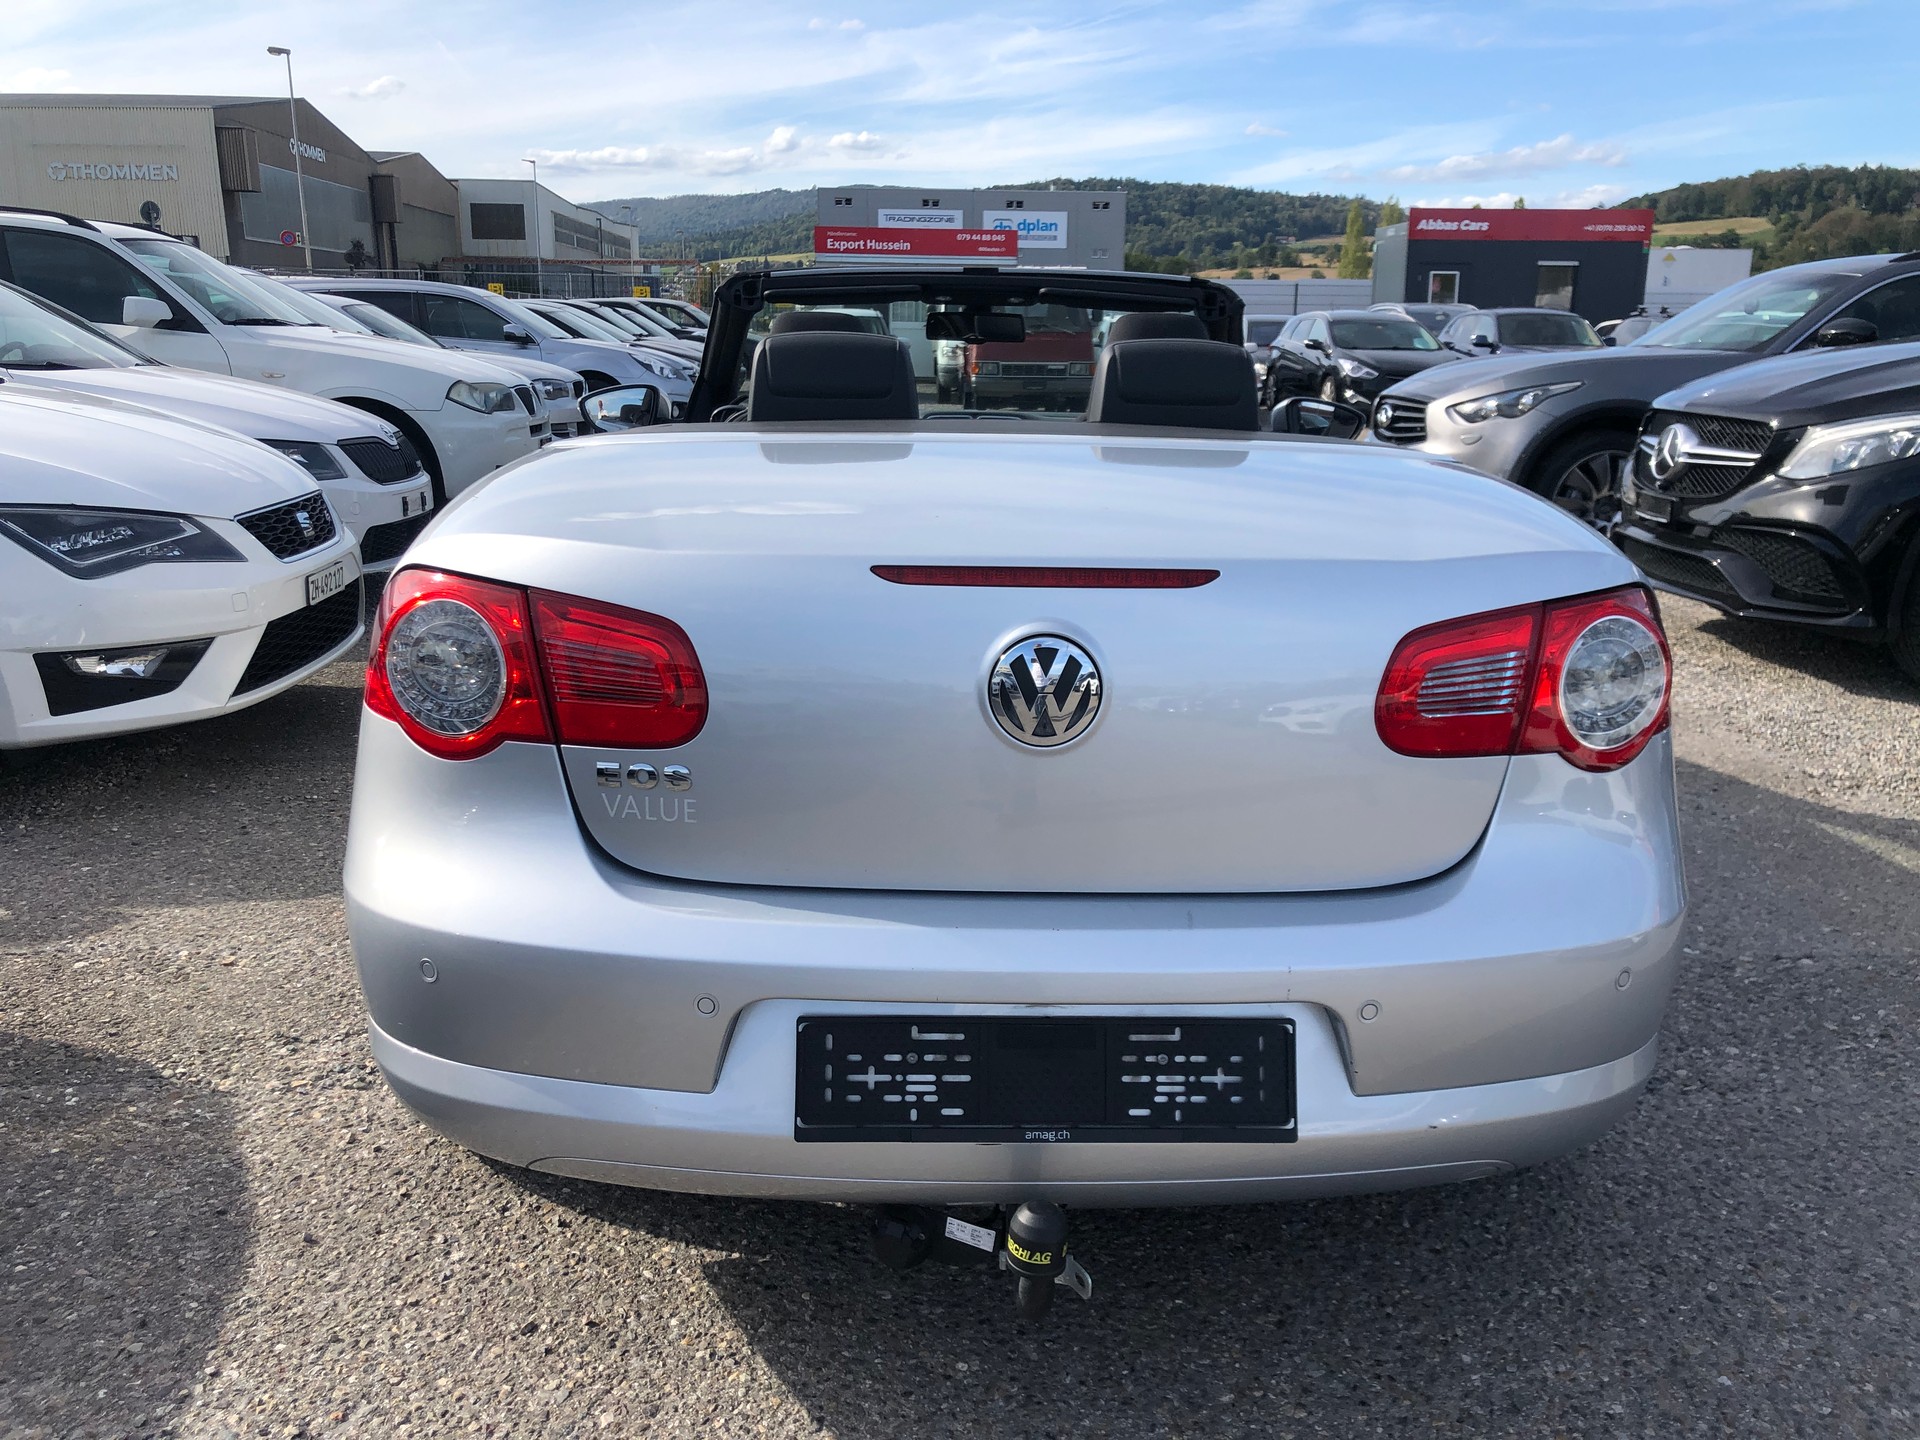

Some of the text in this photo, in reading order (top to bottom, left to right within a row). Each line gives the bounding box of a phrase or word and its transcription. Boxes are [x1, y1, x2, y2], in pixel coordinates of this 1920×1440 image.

[1017, 218, 1058, 234] dplan
[1416, 219, 1490, 231] Abbas Cars
[827, 238, 911, 251] Export Hussein
[596, 761, 693, 793] EOS
[601, 793, 697, 823] VALUE
[1025, 1130, 1070, 1141] amag.ch
[1031, 1252, 1052, 1262] AG
